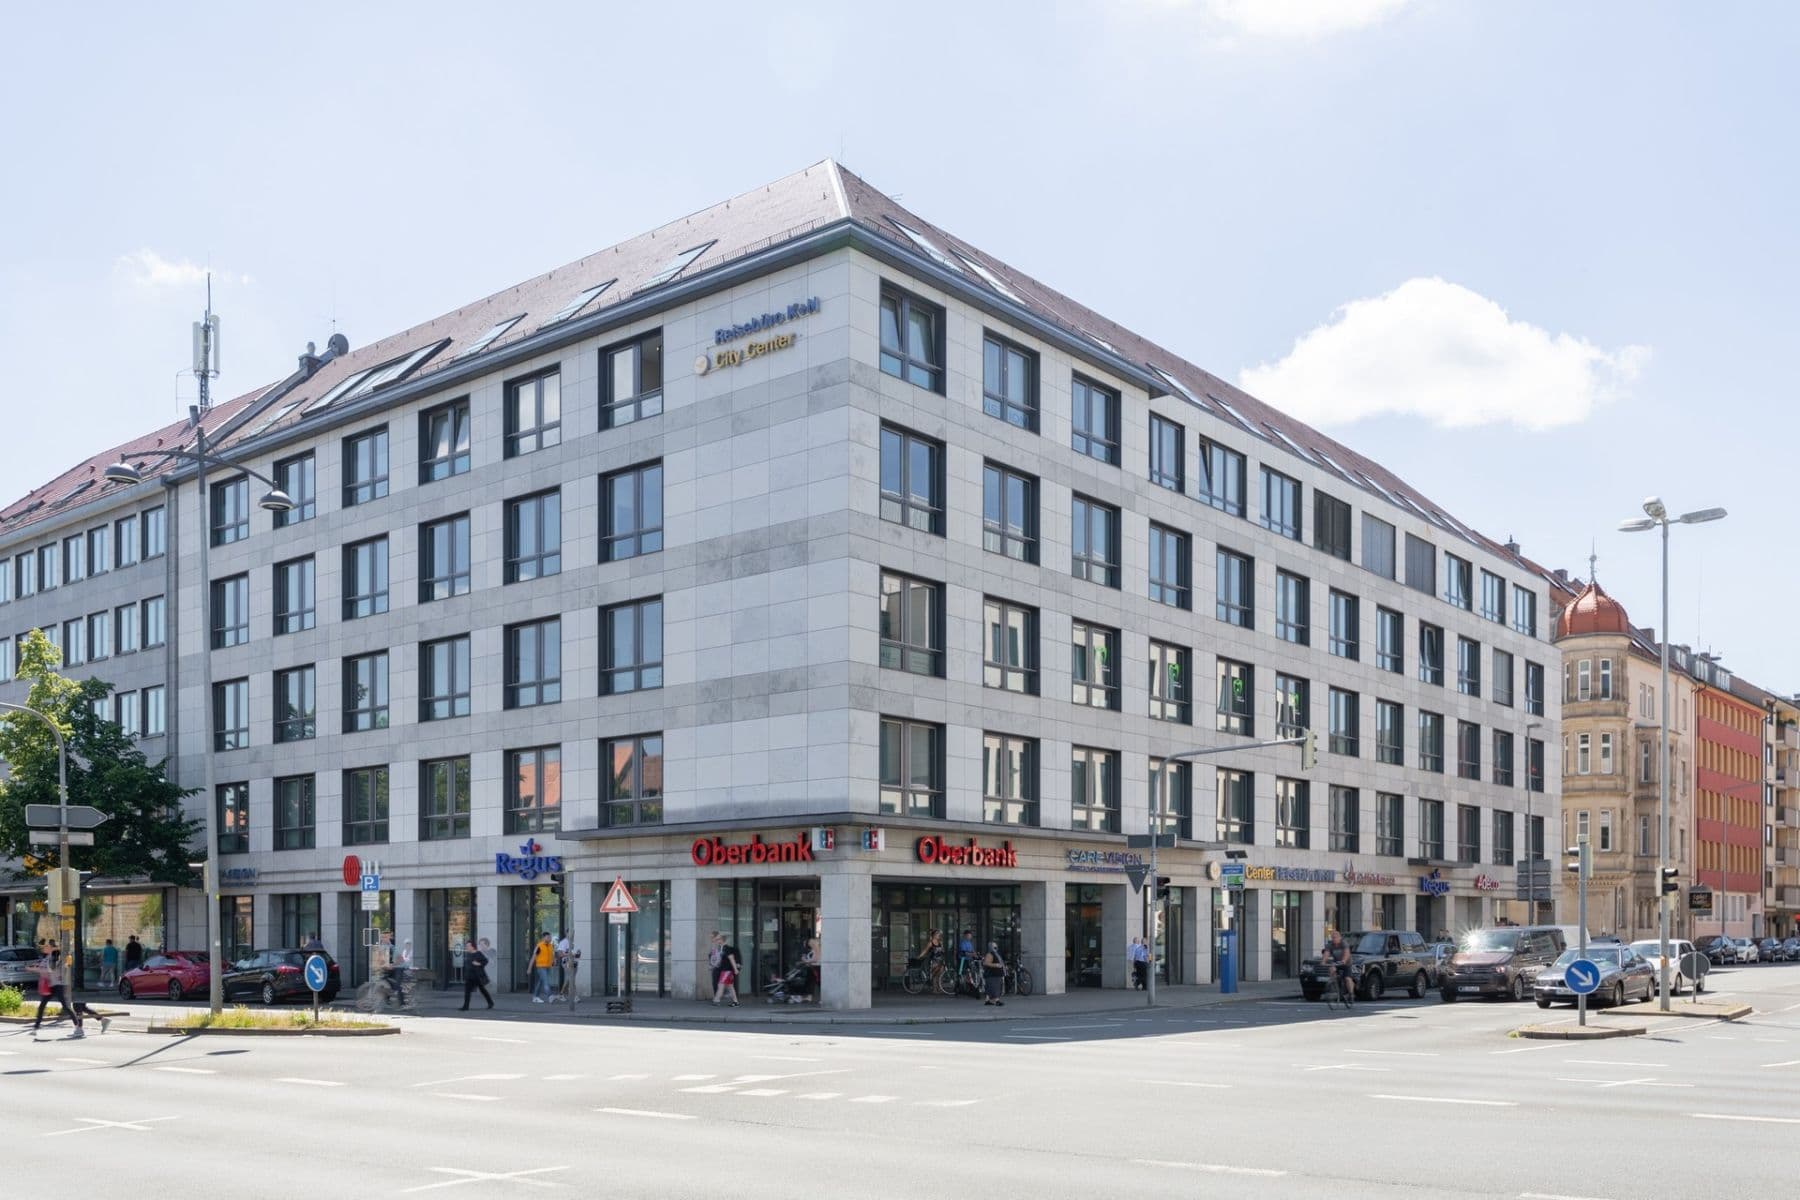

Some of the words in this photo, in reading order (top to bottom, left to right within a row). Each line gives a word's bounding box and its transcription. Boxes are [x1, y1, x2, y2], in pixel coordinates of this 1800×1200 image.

[715, 312, 785, 345] Reisebüro
[716, 350, 743, 369] City
[747, 334, 796, 359] Center
[691, 834, 815, 866] Oberbank
[917, 836, 1020, 868] Oberbank
[364, 877, 374, 889] P
[495, 853, 562, 881] Regus
[1245, 863, 1275, 881] Center
